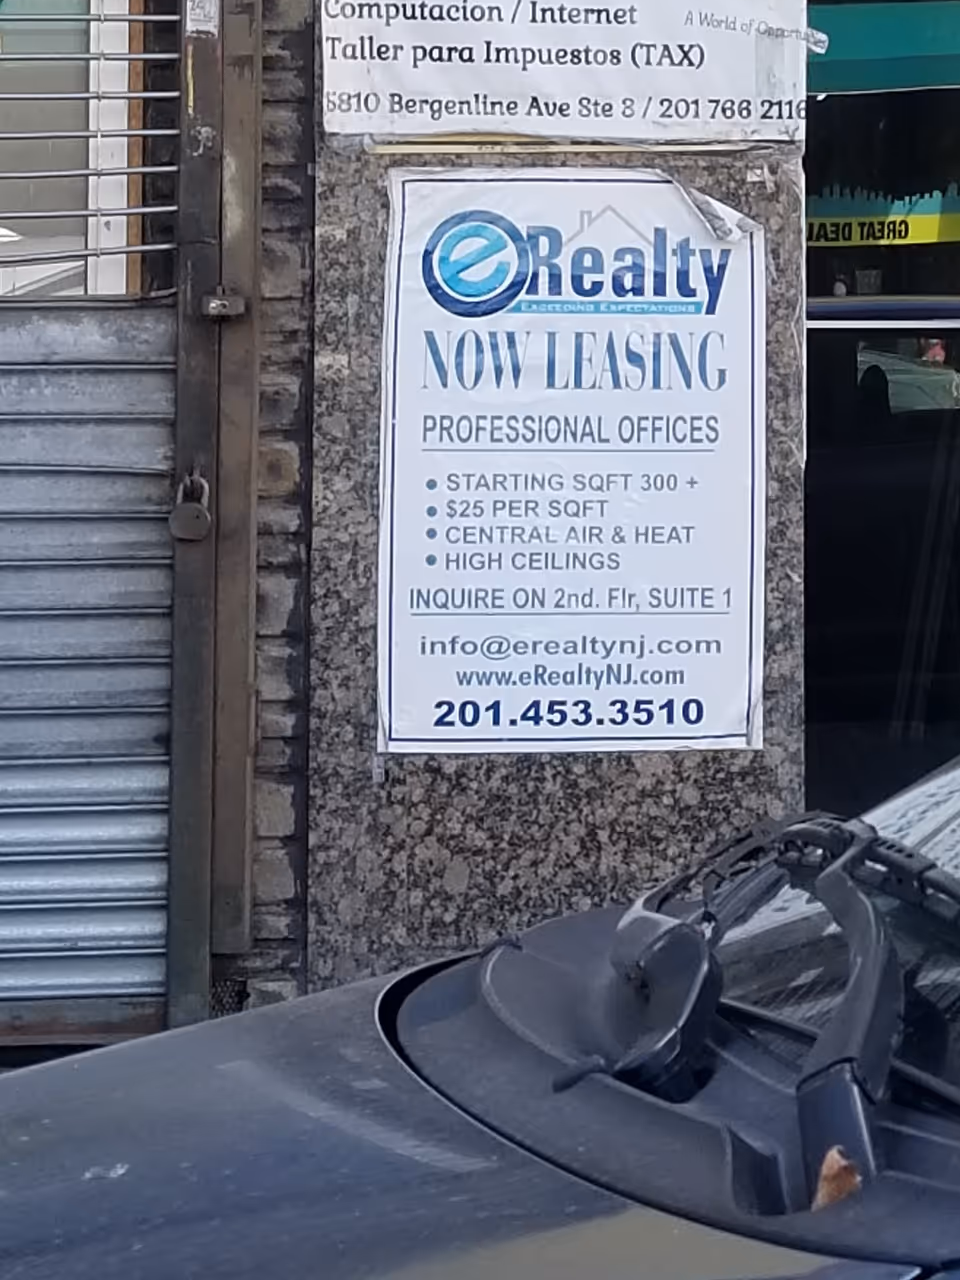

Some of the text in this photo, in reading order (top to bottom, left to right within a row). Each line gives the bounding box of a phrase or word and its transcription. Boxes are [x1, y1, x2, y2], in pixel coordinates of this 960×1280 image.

[511, 0, 522, 24] /
[529, 1, 638, 25] Internet
[684, 10, 694, 26] A
[699, 12, 736, 31] World
[741, 19, 754, 35] of
[325, 35, 705, 71] Taller para Impuestos (TAX)
[326, 91, 381, 114] 5810
[388, 92, 518, 121] Bergenline
[525, 96, 570, 117] Ave
[578, 97, 613, 118] Ste
[642, 96, 653, 119] /
[659, 98, 700, 119] 201
[421, 329, 728, 392] NOW LEASING
[422, 414, 720, 444] PROFESSIONAL OFFICES
[446, 473, 564, 493] STARTING
[572, 473, 634, 494] SQFT
[640, 474, 677, 493] 300
[446, 499, 608, 519] $25 PER SQFT
[445, 525, 695, 545] CENTRAL AIR & HEAT
[445, 552, 621, 571] HIGH CEILINGS
[410, 587, 732, 612] INQUIRE ON 2nd. Flr, SUITE 1
[420, 635, 722, 661] info@erealtynj.com
[456, 664, 685, 691] www.eRealtyNJ.com
[433, 698, 705, 728] 201.453.3510
